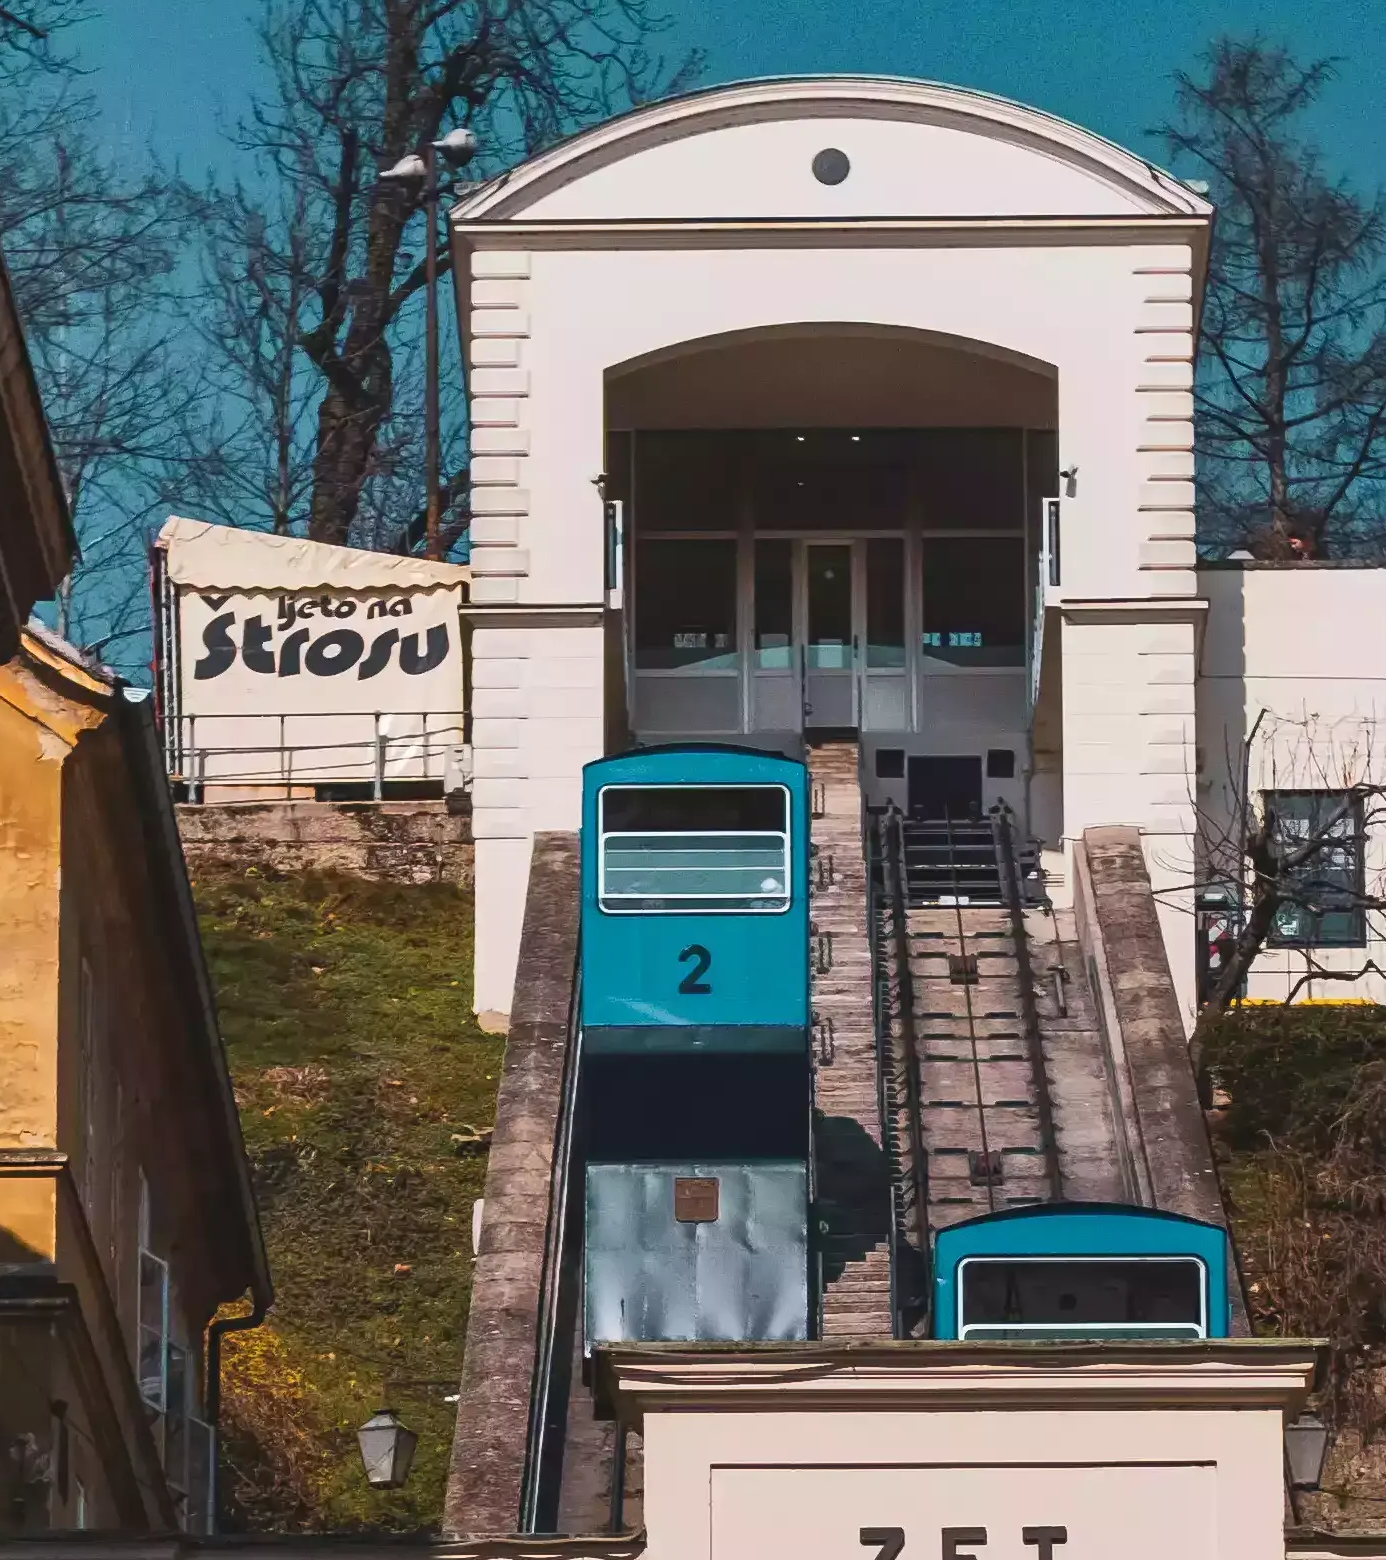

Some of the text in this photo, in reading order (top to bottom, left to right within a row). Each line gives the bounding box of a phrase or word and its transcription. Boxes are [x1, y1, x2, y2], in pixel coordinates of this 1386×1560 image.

[366, 597, 413, 620] na
[193, 595, 450, 681] Štrosu
[678, 944, 712, 994] 2
